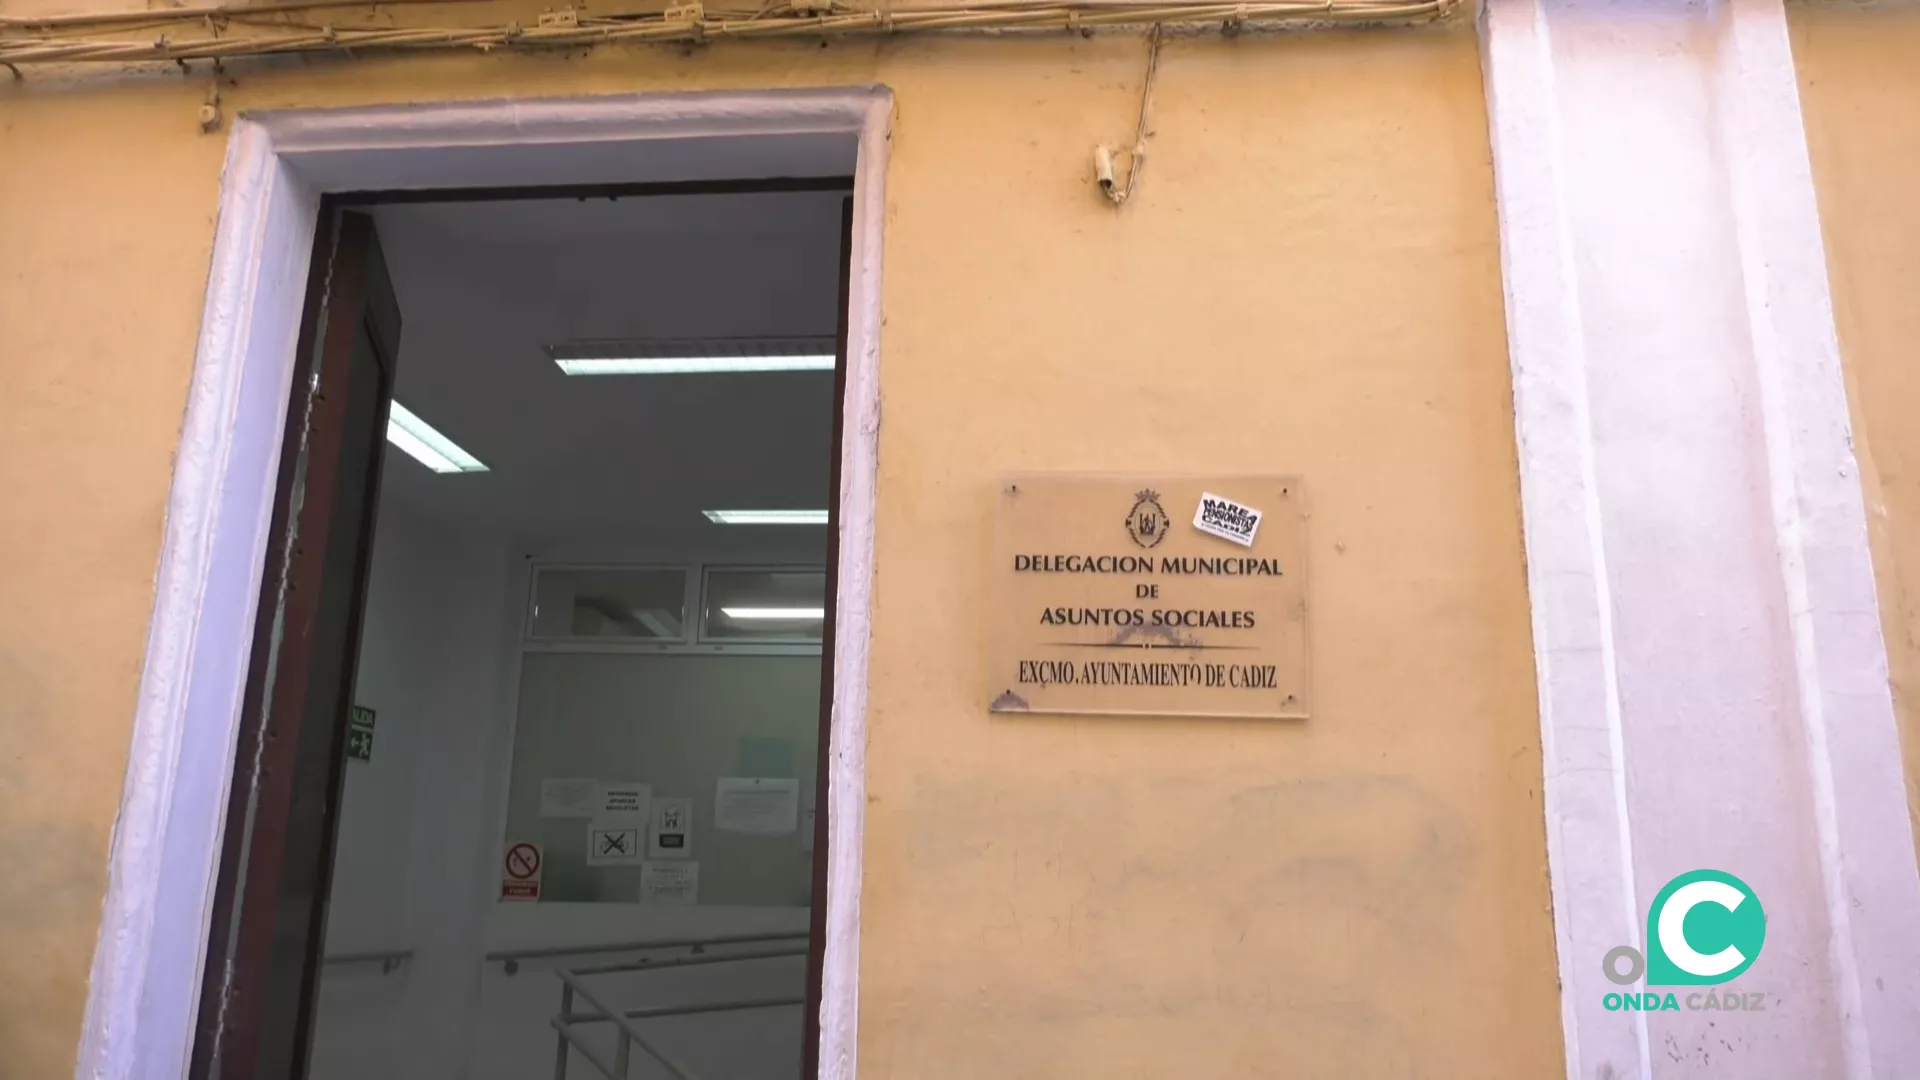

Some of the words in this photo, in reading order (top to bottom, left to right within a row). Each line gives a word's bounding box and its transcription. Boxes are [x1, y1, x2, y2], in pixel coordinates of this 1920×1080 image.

[1014, 554, 1154, 574] DELEGACION
[1161, 556, 1283, 576] MUNICIPAL
[1135, 583, 1159, 599] DE
[1039, 607, 1145, 627] ASUNTOS
[1151, 609, 1256, 629] SOCIALES
[1205, 663, 1226, 688] DE
[1229, 664, 1278, 689] CADIZ
